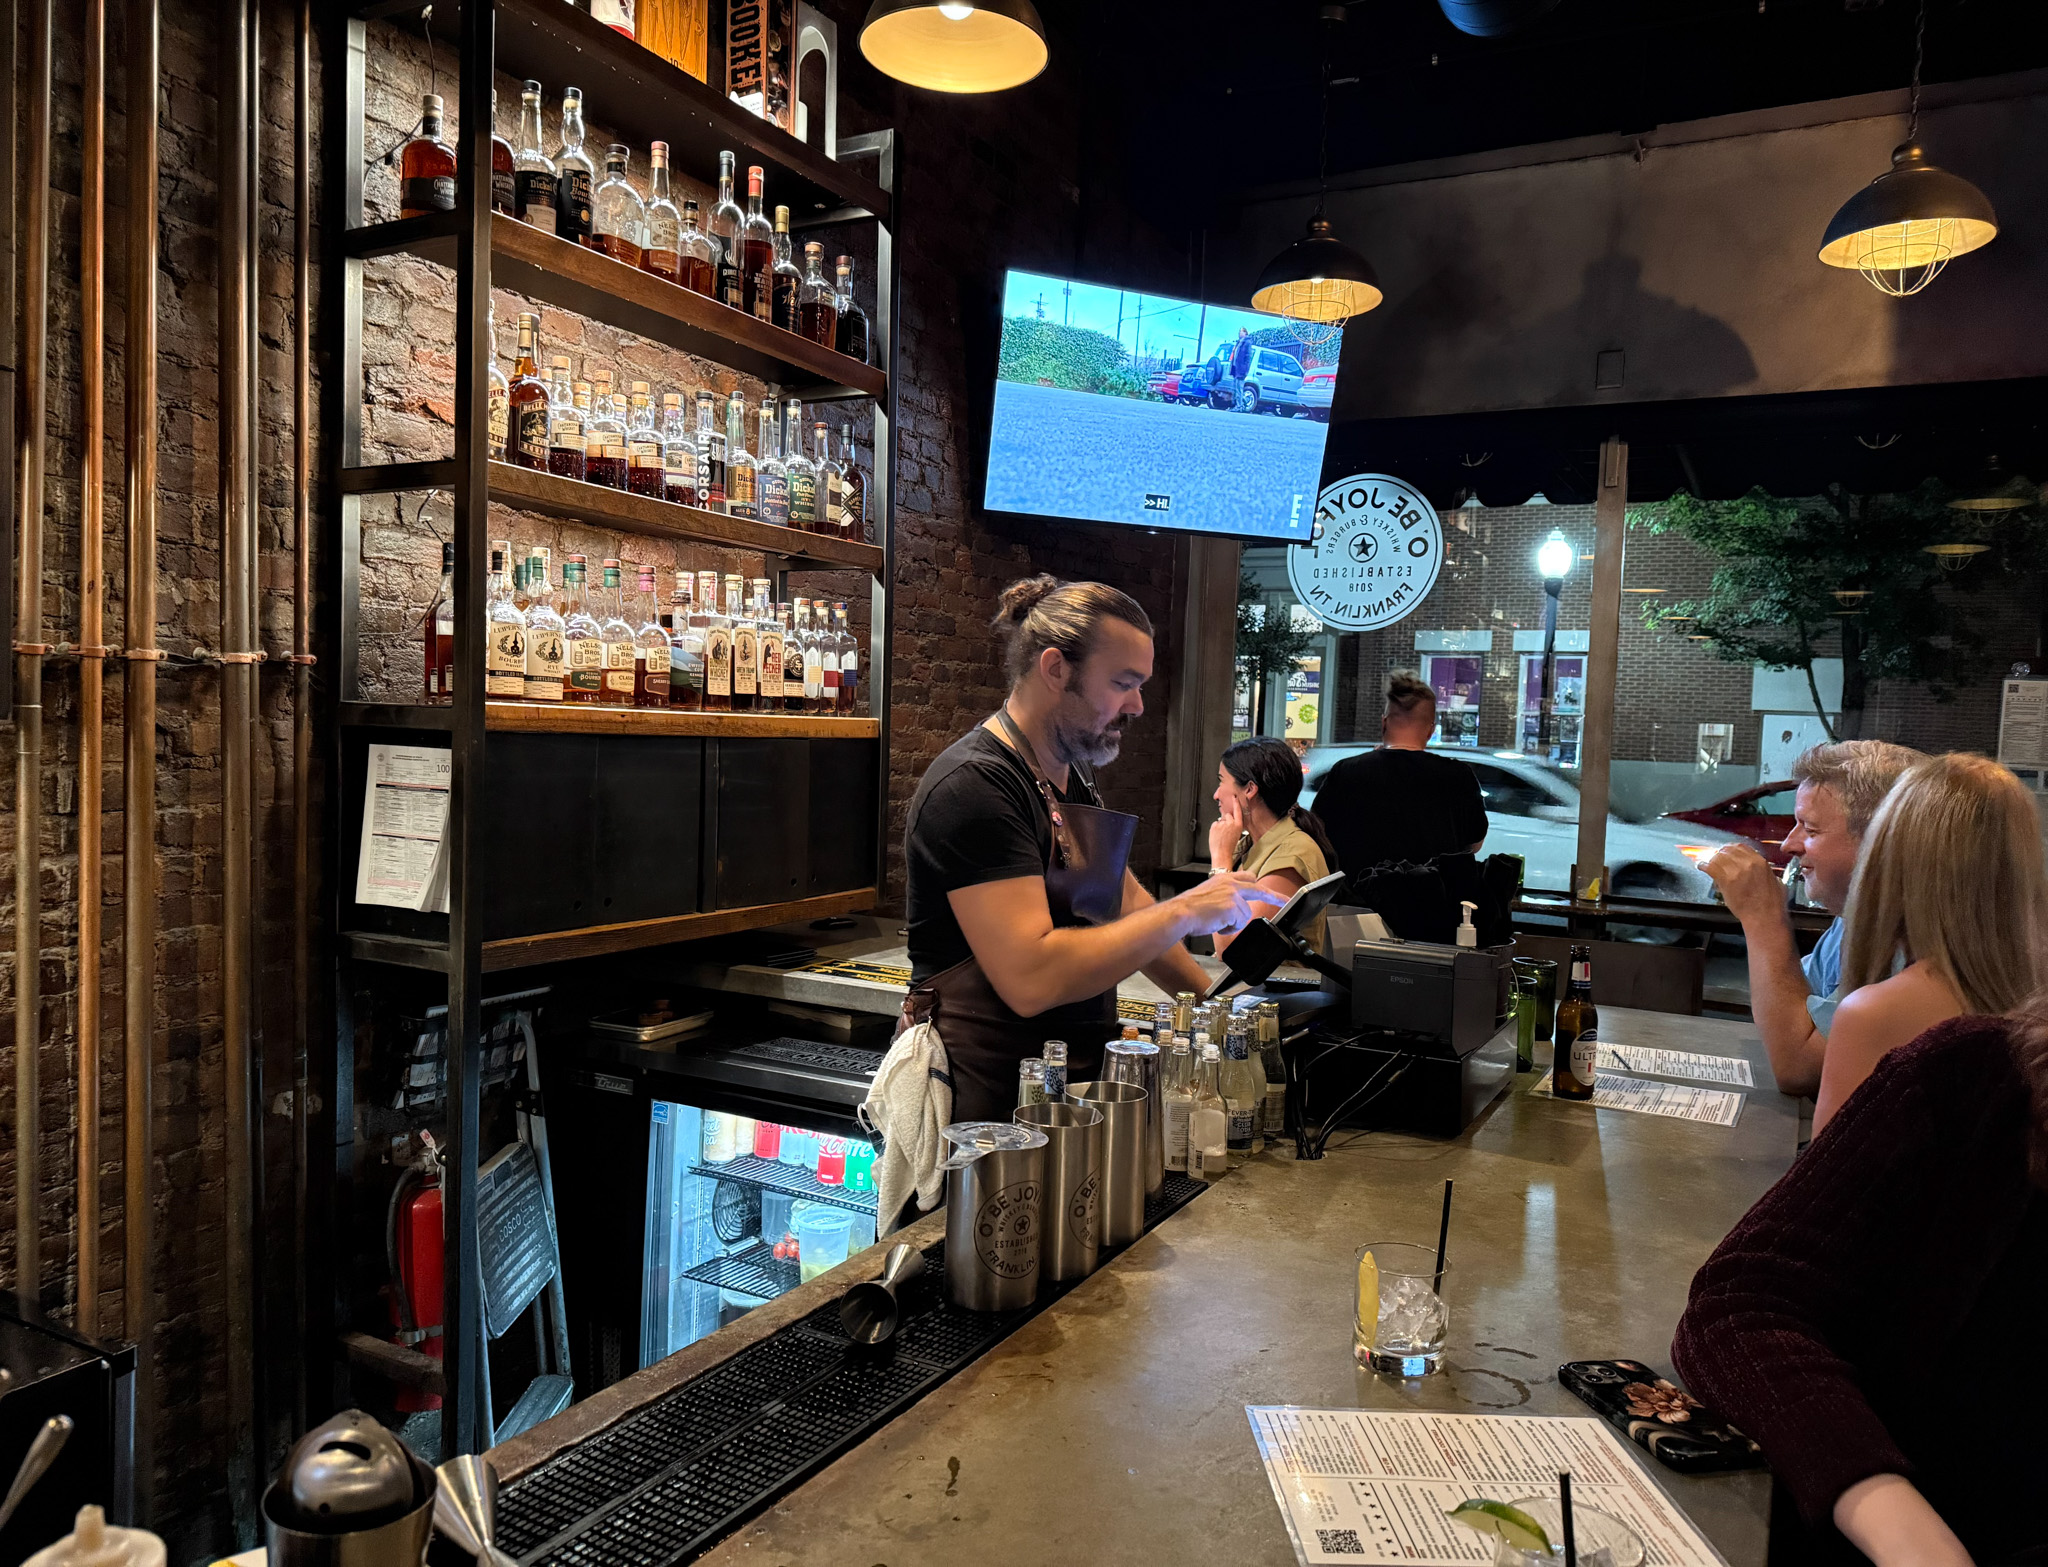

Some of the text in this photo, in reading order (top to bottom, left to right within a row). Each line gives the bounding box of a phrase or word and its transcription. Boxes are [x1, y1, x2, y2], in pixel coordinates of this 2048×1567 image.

[698, 434, 710, 511] CORSAIR
[765, 484, 788, 496] Dicke
[793, 481, 815, 493] Dicke
[437, 763, 451, 774] 100
[1390, 975, 1414, 985] EPSON
[1574, 1051, 1597, 1061] ULTR
[1227, 1108, 1254, 1116] FEVER-T
[1080, 1177, 1097, 1199] BE
[988, 1195, 1011, 1218] BE
[1013, 1186, 1041, 1205] JOY
[994, 1233, 1039, 1249] ESTABLISHE
